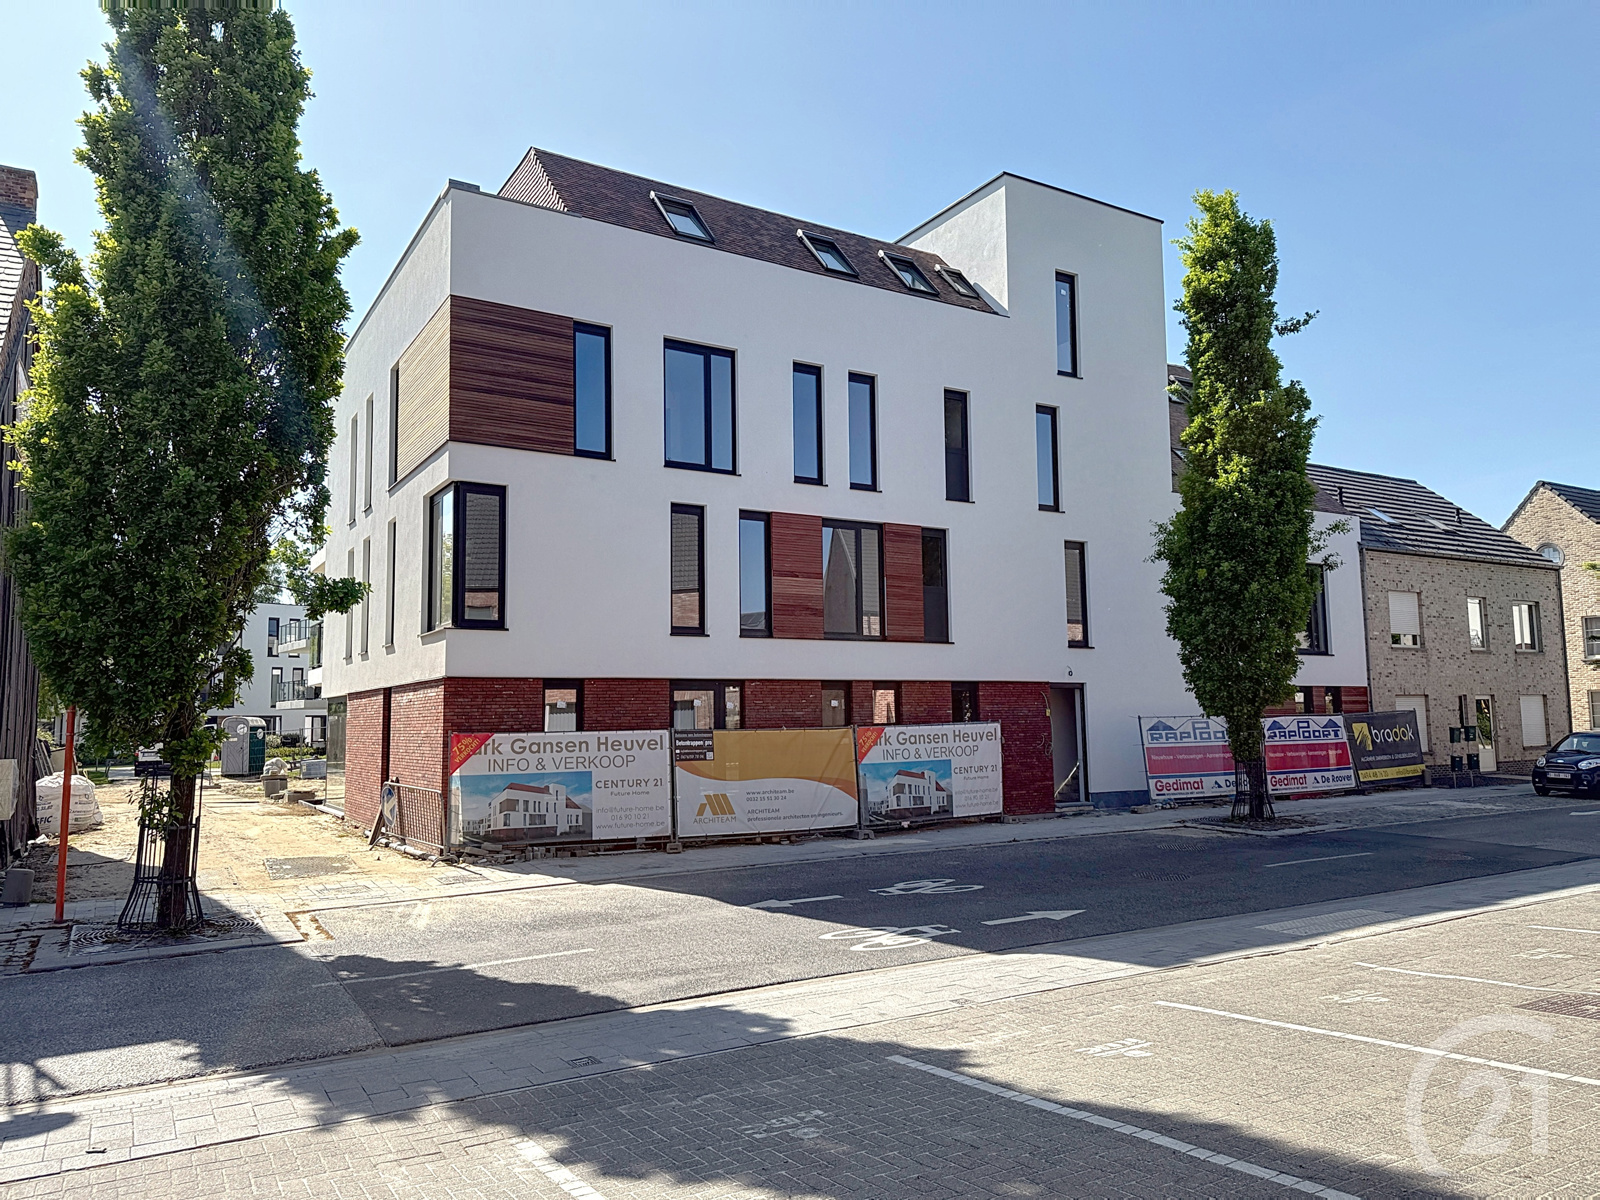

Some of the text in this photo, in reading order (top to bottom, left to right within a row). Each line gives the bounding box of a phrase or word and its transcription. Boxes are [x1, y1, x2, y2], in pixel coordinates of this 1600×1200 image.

[896, 731, 949, 746] Gansen
[953, 727, 997, 743] Heuvel
[1370, 723, 1415, 743] bradok
[452, 736, 473, 755] 75%
[454, 738, 482, 763] VERKOCHT!
[510, 737, 589, 755] Gansen
[597, 734, 664, 752] Heuvel
[882, 744, 979, 761] INFO & VERKOOP
[488, 754, 636, 773] INFO & VERKOOP
[953, 764, 998, 775] CENTURY 21
[595, 777, 663, 789] CENTURY 21
[1154, 778, 1204, 792] Gedimat
[1270, 773, 1308, 788] Gedimat
[1321, 775, 1331, 784] De
[745, 788, 795, 796] www.architeam.be
[642, 812, 650, 820] 21
[693, 816, 737, 825] ARCHITEAM
